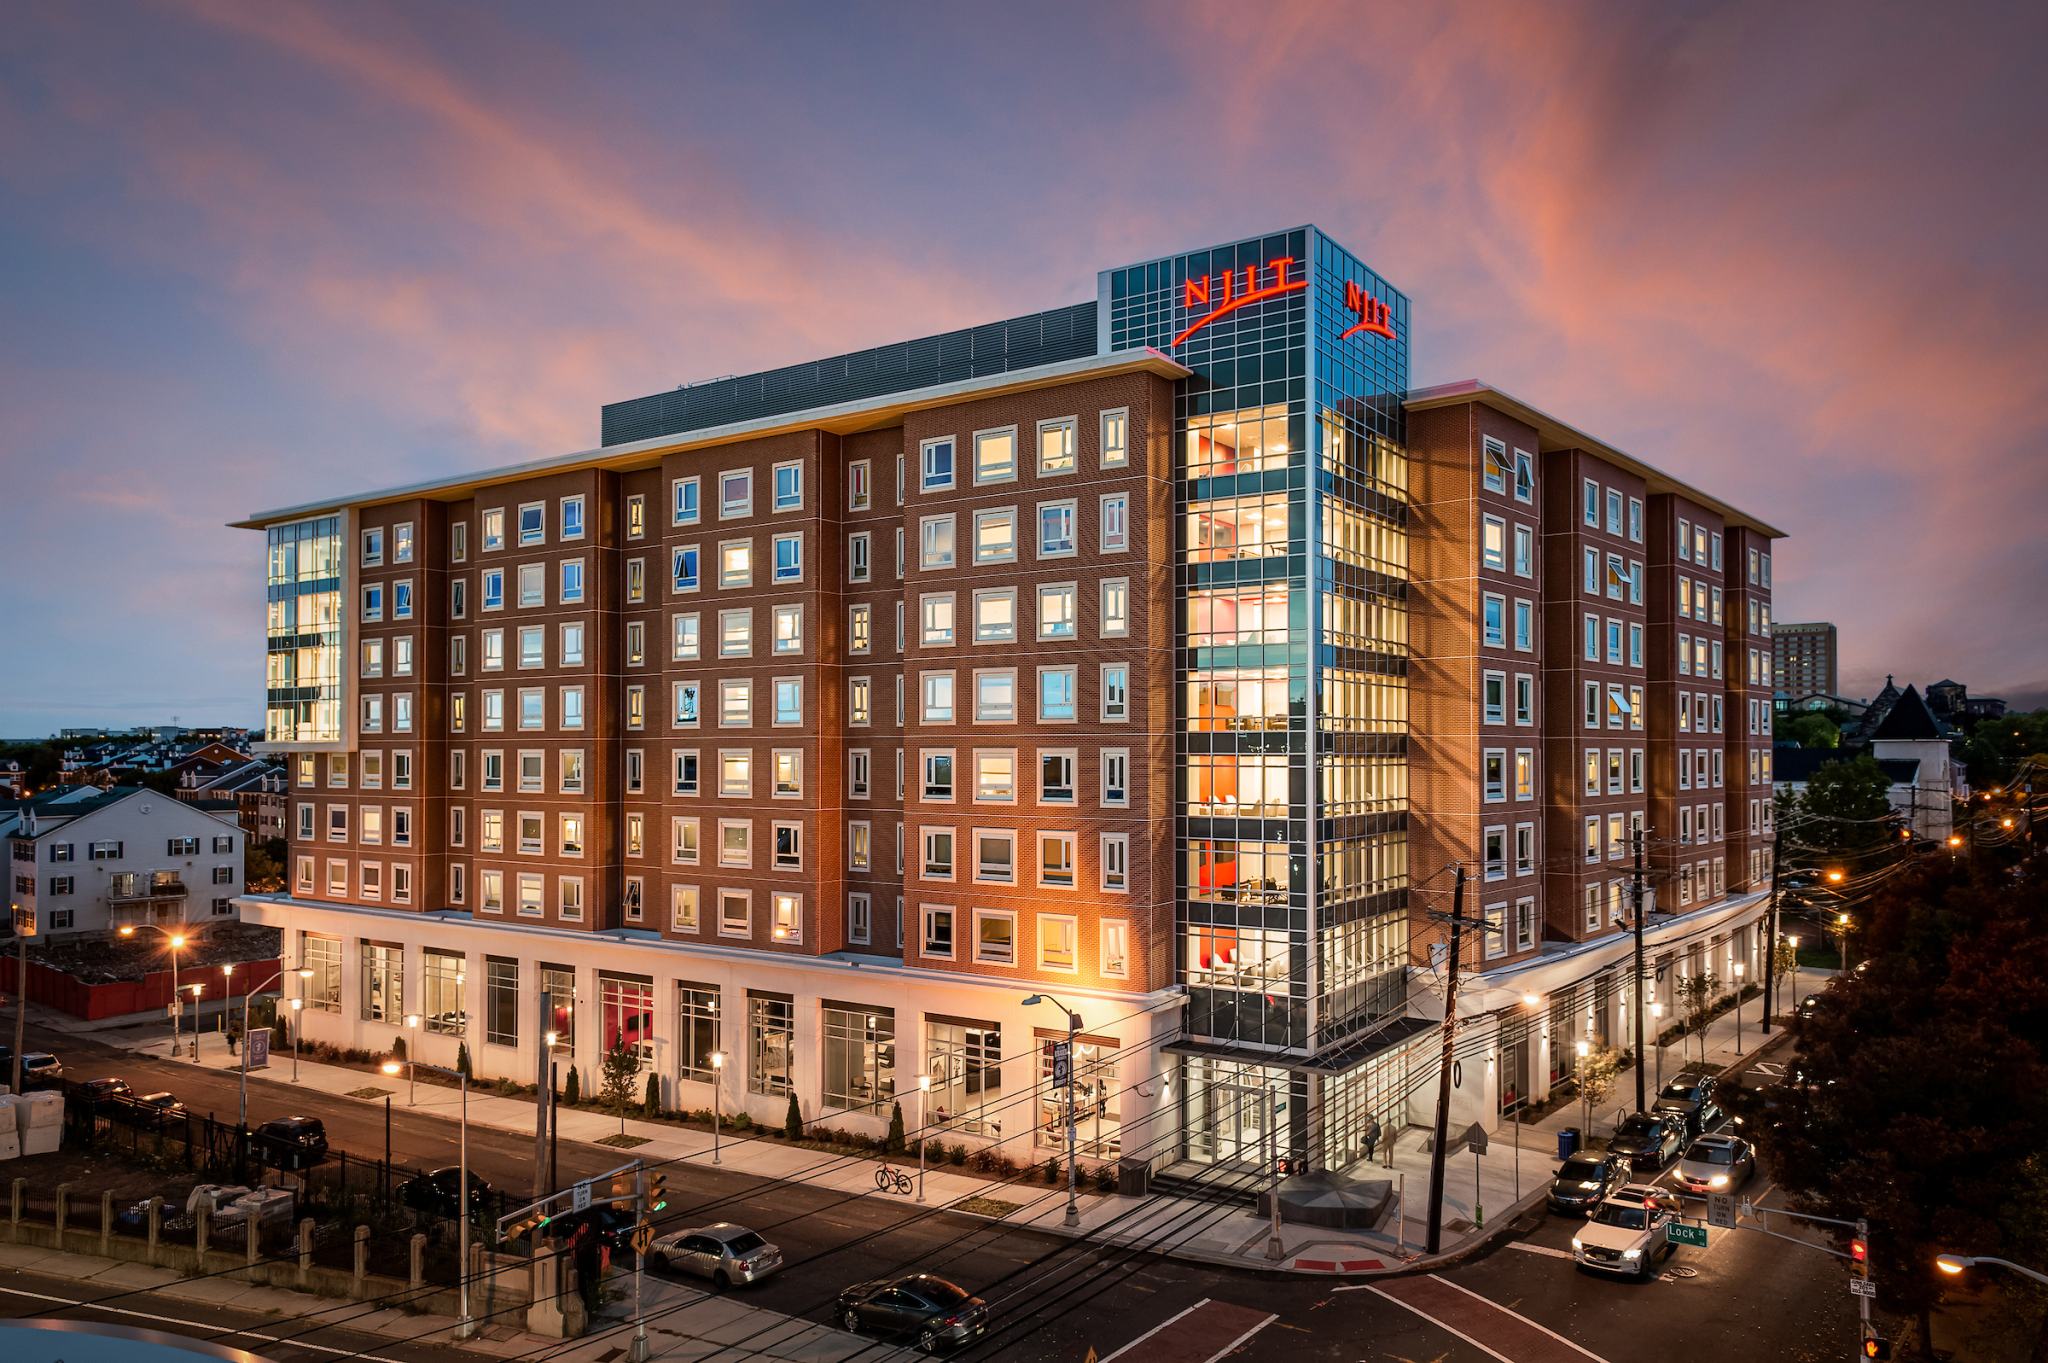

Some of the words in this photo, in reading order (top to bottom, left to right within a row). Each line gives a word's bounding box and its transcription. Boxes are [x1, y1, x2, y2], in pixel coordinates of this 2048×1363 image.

[1185, 257, 1294, 308] NJIT
[1345, 279, 1392, 331] NJIT
[1714, 1196, 1728, 1204] NO
[1713, 1204, 1730, 1212] TURN
[1669, 1224, 1695, 1239] Lock
